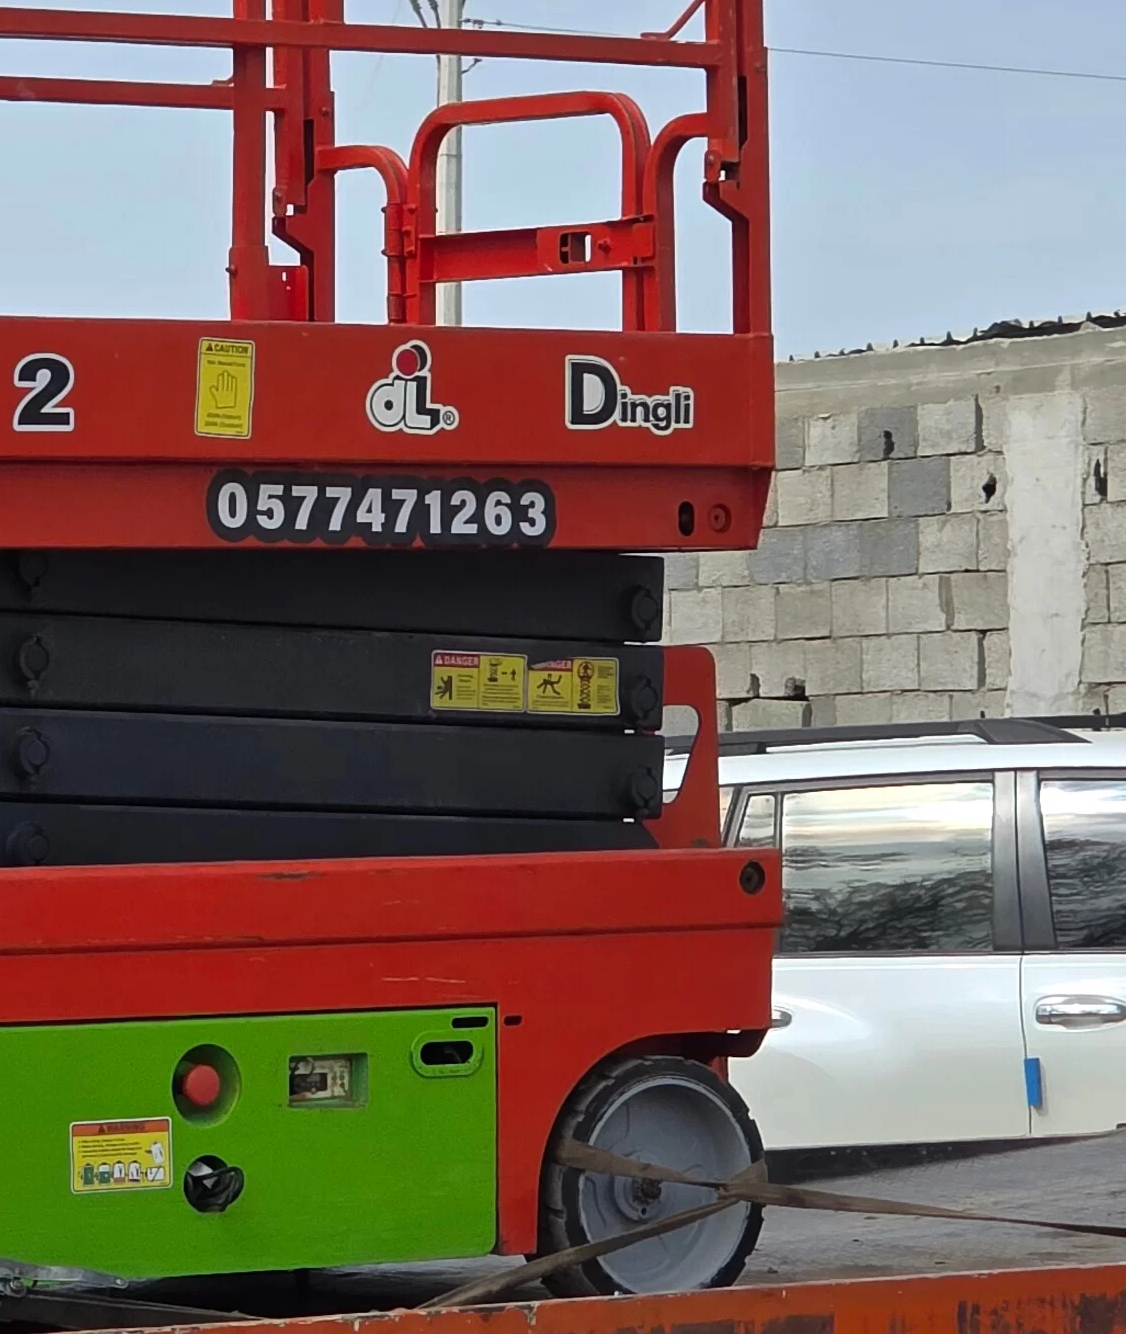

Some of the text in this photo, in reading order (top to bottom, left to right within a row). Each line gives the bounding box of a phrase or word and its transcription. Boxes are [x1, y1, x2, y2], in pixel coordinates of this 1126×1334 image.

[566, 355, 693, 435] Dingli
[216, 482, 547, 537] 0577471263
[443, 655, 479, 666] DANGER
